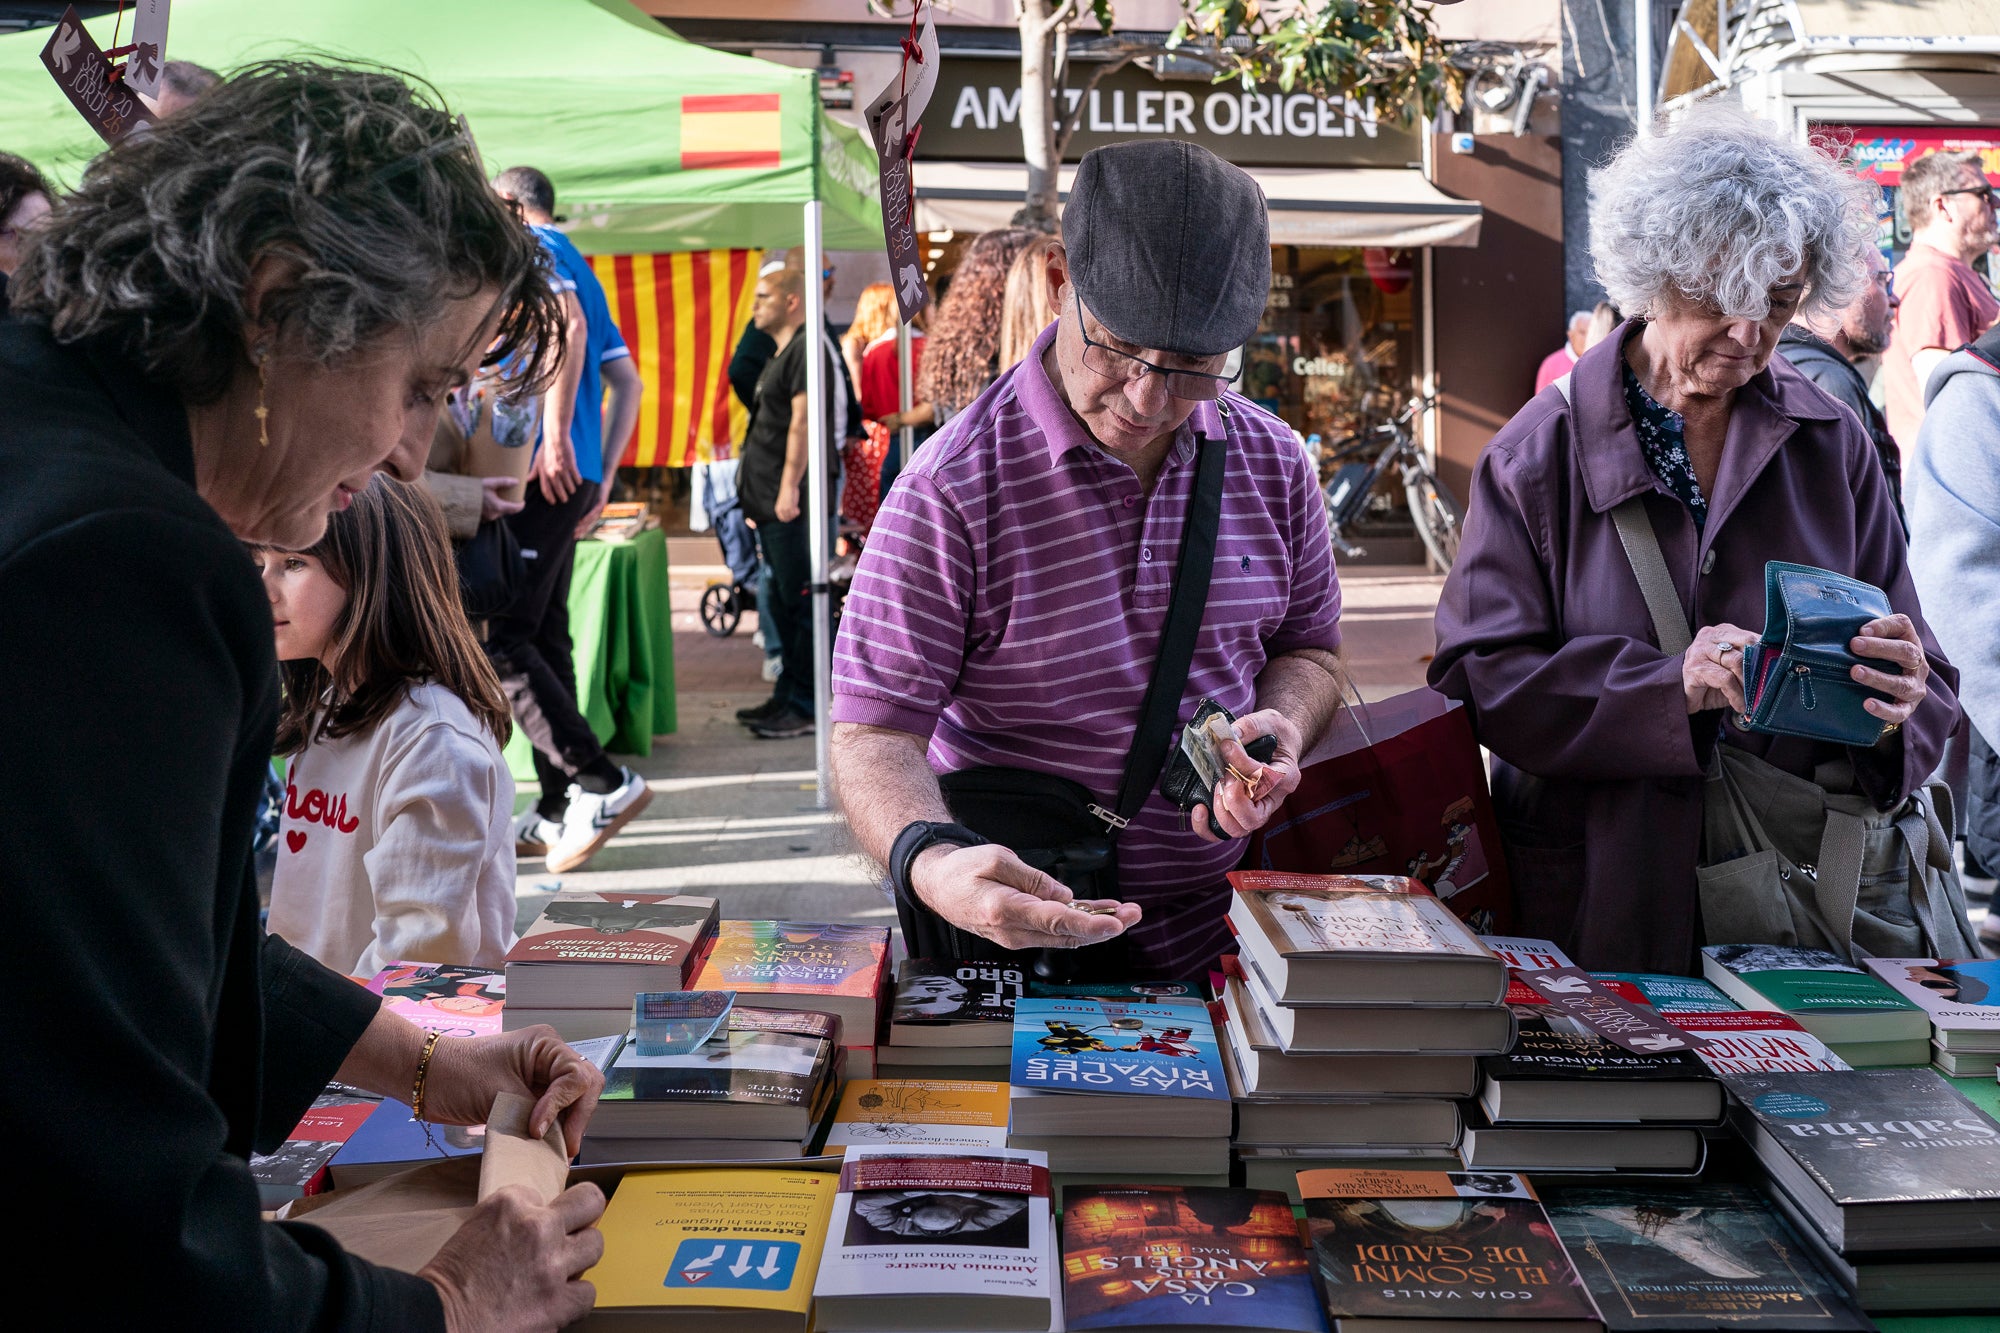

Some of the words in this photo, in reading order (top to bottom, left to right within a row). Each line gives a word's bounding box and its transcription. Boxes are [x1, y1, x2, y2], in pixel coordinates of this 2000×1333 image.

[69, 68, 109, 118] JORDI
[103, 109, 124, 135] 26
[112, 92, 132, 118] 20
[950, 86, 1196, 134] AMTLLER
[1204, 91, 1379, 138] ORIGEN
[884, 163, 904, 231] JORDI
[892, 158, 907, 216] SANT
[901, 223, 913, 251] 20
[892, 230, 904, 259] 26
[558, 951, 617, 959] CERCAS
[620, 946, 653, 954] loco
[752, 950, 833, 959] BUENA
[620, 952, 672, 961] JAVIER
[800, 957, 848, 966] UNA
[1523, 953, 1562, 969] EL
[729, 964, 844, 974] BENAVENT
[731, 969, 836, 980] ELISABET
[956, 968, 1022, 982] GRO
[995, 981, 1024, 999] LI
[1107, 1008, 1172, 1016] RACHEL
[426, 1019, 474, 1027] mare
[1580, 1011, 1625, 1034] SANT
[1600, 1007, 1660, 1031] JORDI
[479, 1022, 498, 1030] La
[1523, 1042, 1620, 1050] UCACIÓN
[1062, 1054, 1114, 1062] RIVALRY
[1116, 1057, 1175, 1066] HEATED
[1509, 1055, 1606, 1066] MÍNGUEZ
[1027, 1058, 1209, 1081] RIVALES
[1025, 1068, 1114, 1084] QUE
[1129, 1075, 1214, 1092] MÁS
[666, 1088, 736, 1096] Aramburu
[748, 1084, 804, 1094] MAITE
[739, 1091, 801, 1102] Fernando
[1769, 1107, 1825, 1115] Obsequio
[317, 1120, 344, 1128] Les
[1783, 1120, 1996, 1141] Sabina
[1334, 1182, 1391, 1190] SAGRADA
[731, 1202, 773, 1210] Albert
[779, 1203, 812, 1211] Joan
[779, 1209, 810, 1218] Jordi
[655, 1217, 725, 1226] juguem?
[682, 1226, 729, 1234] dreta
[733, 1227, 806, 1236] Extrema
[930, 1252, 975, 1260] como
[1192, 1247, 1230, 1255] MAG
[1356, 1244, 1474, 1264] GAUDÍ
[1482, 1246, 1530, 1264] DE
[841, 1252, 899, 1261] fascista
[1013, 1255, 1038, 1264] Me
[884, 1262, 957, 1271] Maestre
[963, 1263, 1038, 1274] Antonio
[1098, 1256, 1268, 1277] ÀNGELS
[1156, 1268, 1225, 1280] DELS
[1352, 1264, 1496, 1284] SOMNI
[1505, 1267, 1550, 1285] EL
[1131, 1280, 1256, 1296] CASA
[1382, 1289, 1461, 1299] VALLS
[1471, 1290, 1532, 1300] COIA
[1180, 1293, 1211, 1306] LA
[1686, 1301, 1762, 1310] ALBERT
